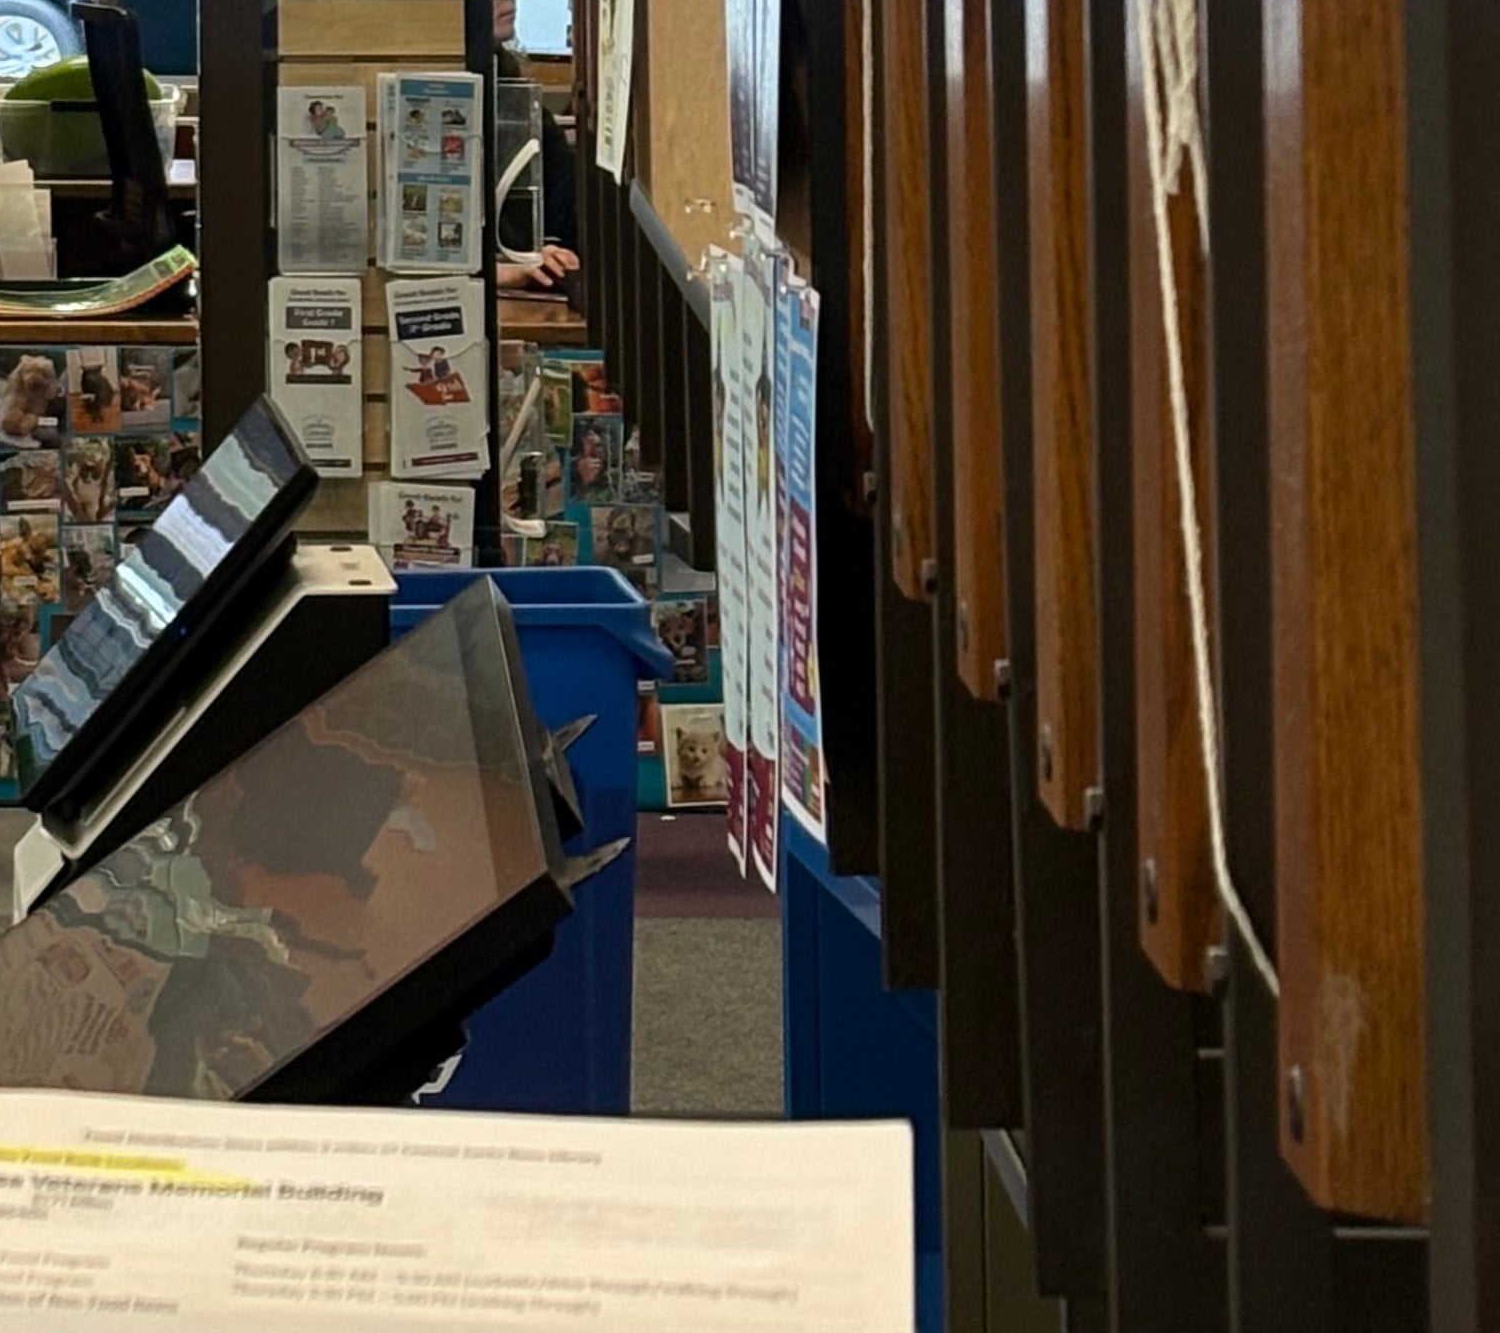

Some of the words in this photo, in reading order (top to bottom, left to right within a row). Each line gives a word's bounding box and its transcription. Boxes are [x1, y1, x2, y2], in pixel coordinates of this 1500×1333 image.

[31, 1172, 142, 1197] Veterans
[151, 1176, 271, 1202] Memorial
[277, 1180, 385, 1206] Building
